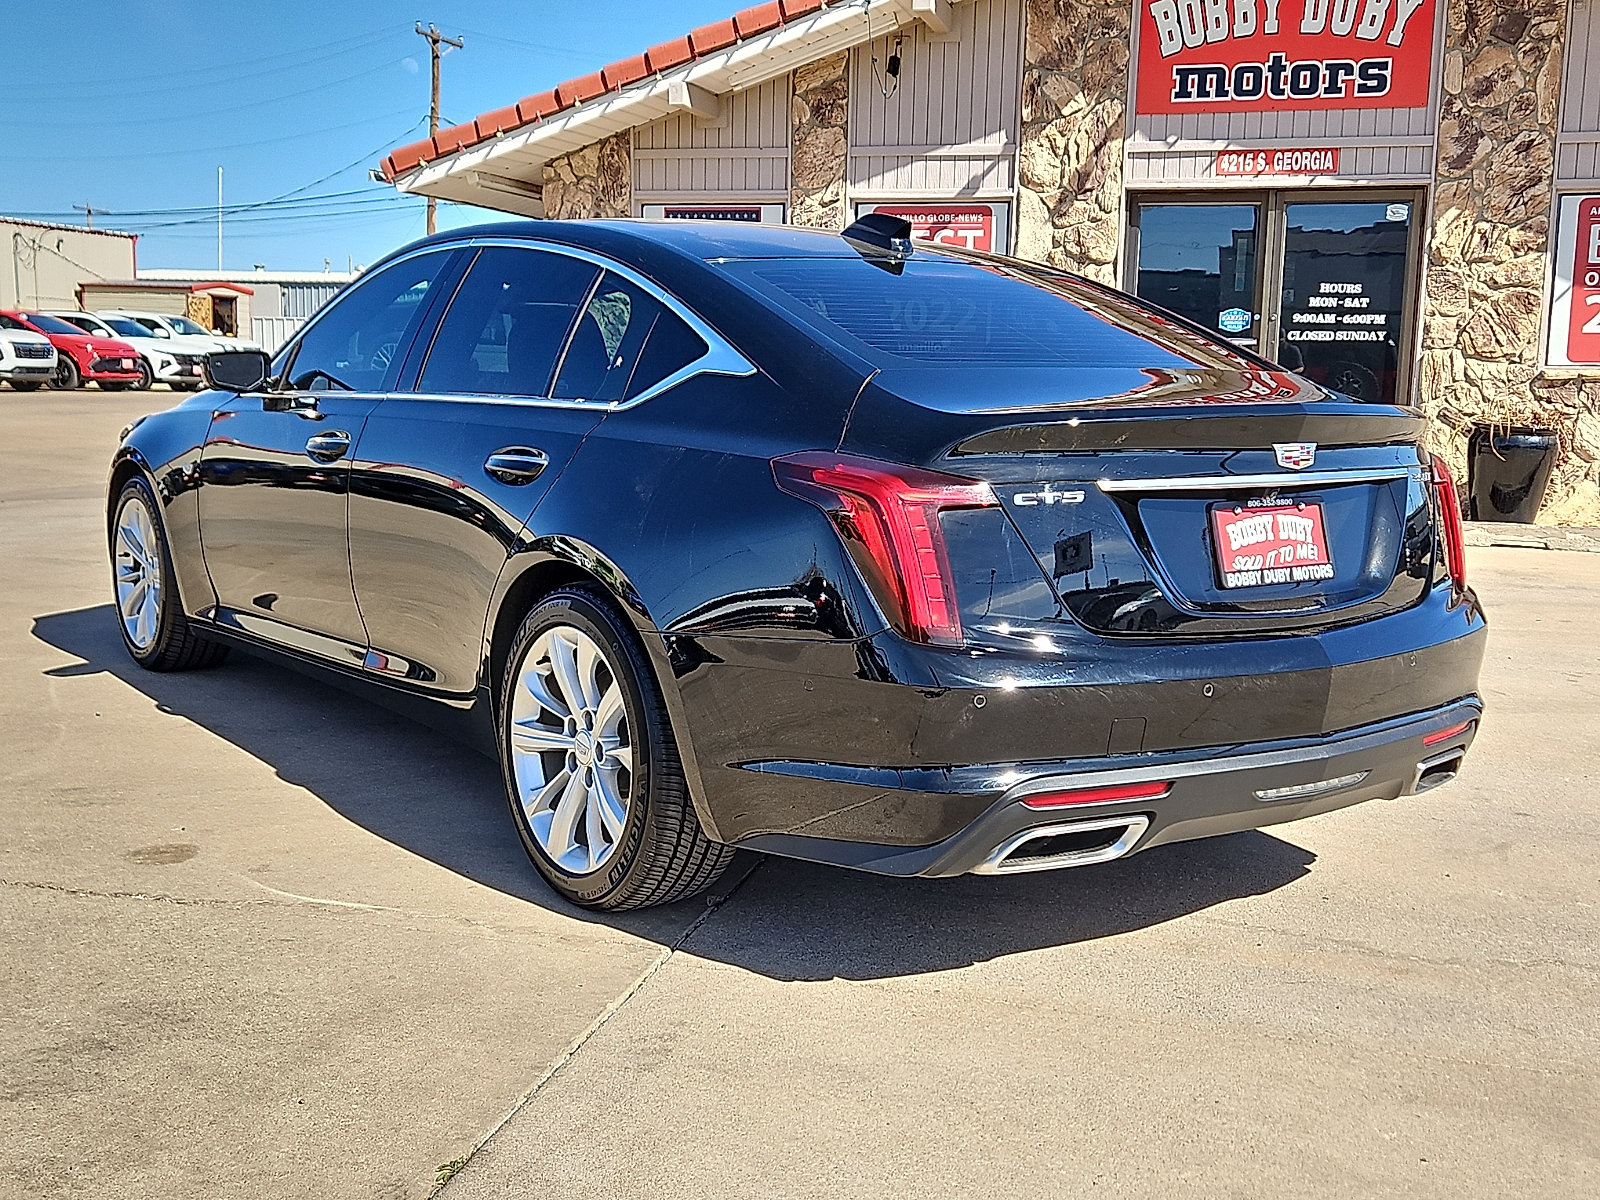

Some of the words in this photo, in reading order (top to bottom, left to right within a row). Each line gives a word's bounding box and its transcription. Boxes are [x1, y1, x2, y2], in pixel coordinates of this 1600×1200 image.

[1150, 0, 1279, 57] BOBBY
[1299, 0, 1424, 47] DUBY
[1171, 52, 1393, 103] motors
[1220, 152, 1254, 172] 4215
[1256, 151, 1270, 172] S.
[1273, 150, 1334, 171] GEORGIA
[1319, 283, 1362, 293] HOURS
[1287, 330, 1334, 341] CLOSED
[1335, 331, 1387, 341] SUNDAY
[1247, 498, 1293, 507] 806-352-9800
[1225, 514, 1275, 551] BOBBY
[1276, 514, 1314, 543] DUBY
[1231, 554, 1264, 571] SOLD
[1265, 549, 1279, 569] IT
[1278, 545, 1294, 564] TO
[1296, 543, 1319, 561] ME!
[1226, 570, 1262, 588] BOBBY
[1263, 567, 1292, 584] DUBY
[1292, 564, 1334, 580] MOTORS
[612, 800, 644, 880] MICHELIN
